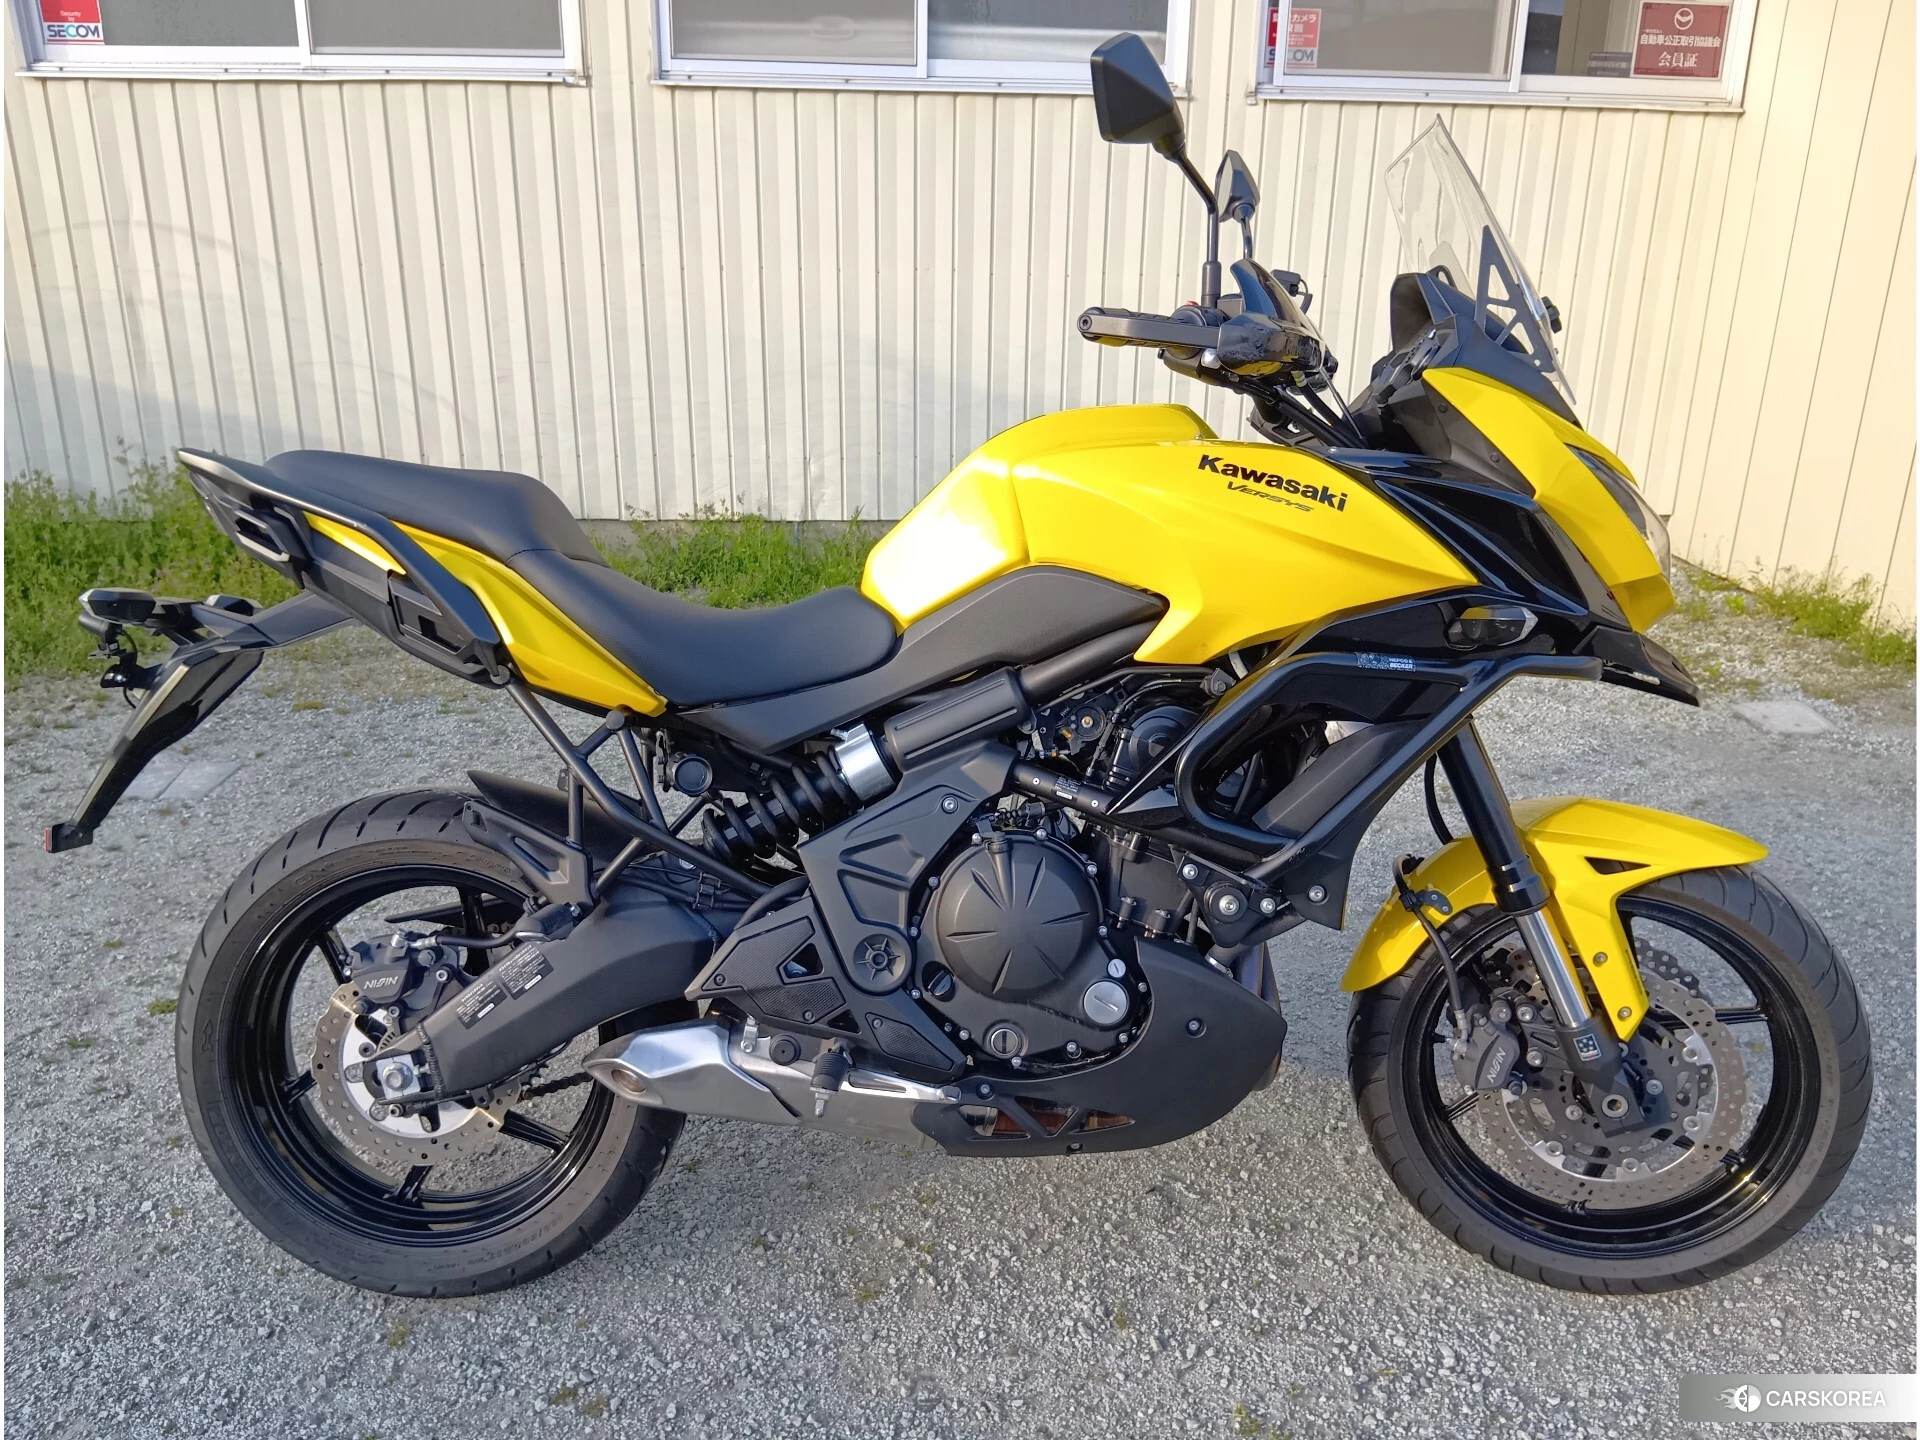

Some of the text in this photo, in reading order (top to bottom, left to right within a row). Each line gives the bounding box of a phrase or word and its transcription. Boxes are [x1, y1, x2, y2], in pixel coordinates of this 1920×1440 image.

[47, 24, 101, 38] SECOM
[1658, 51, 1699, 68] 会員証
[1198, 454, 1348, 512] Kawasaki
